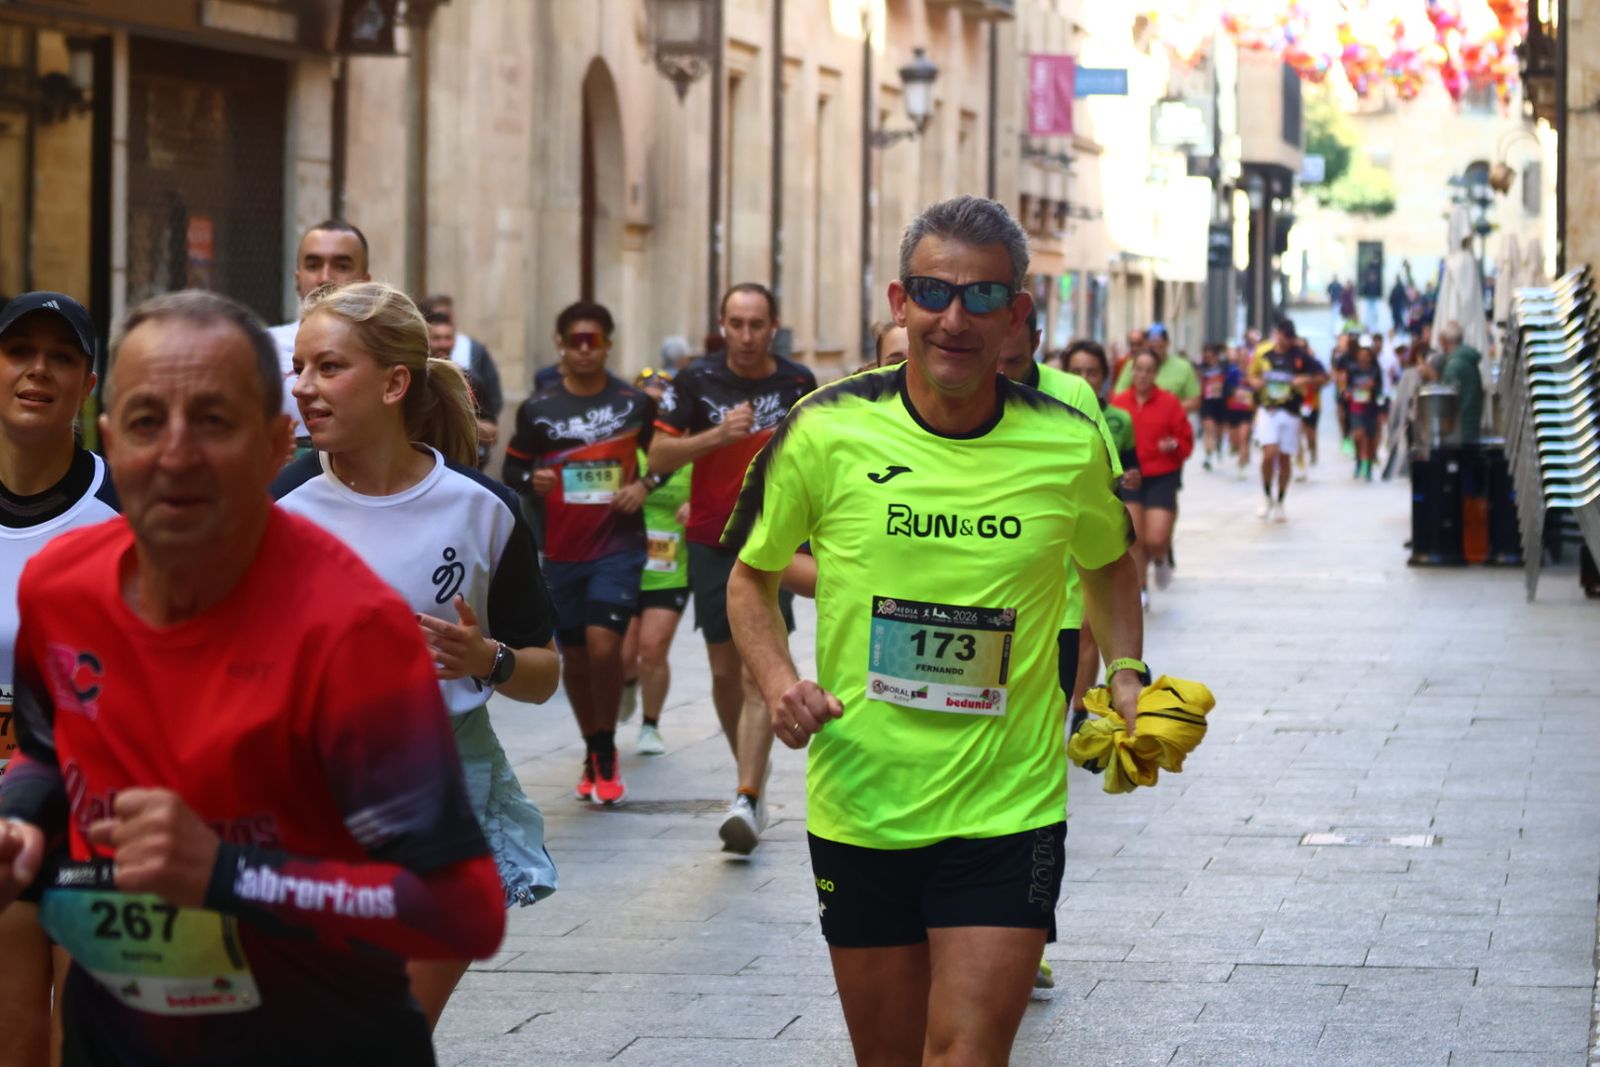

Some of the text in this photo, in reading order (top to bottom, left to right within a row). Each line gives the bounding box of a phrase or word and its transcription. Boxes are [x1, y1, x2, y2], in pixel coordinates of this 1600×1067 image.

[575, 471, 612, 482] 1618
[953, 610, 978, 622] 2026
[910, 630, 976, 661] 173
[915, 663, 964, 676] FERNANDO
[90, 900, 179, 942] 267
